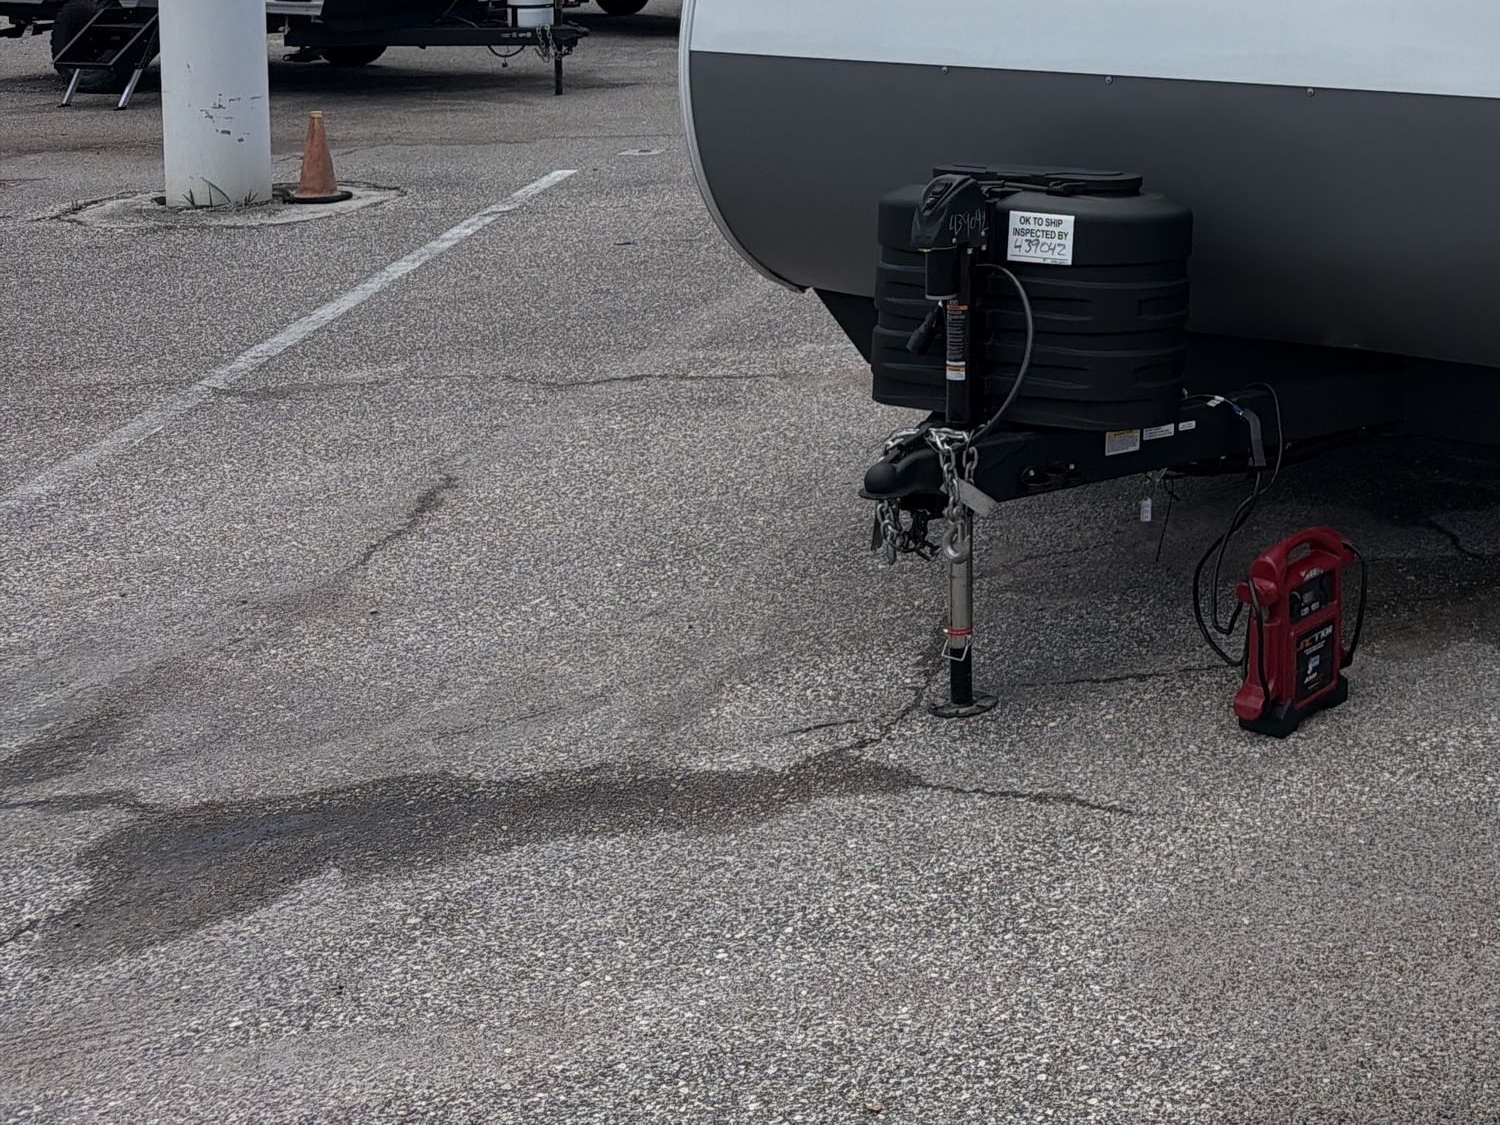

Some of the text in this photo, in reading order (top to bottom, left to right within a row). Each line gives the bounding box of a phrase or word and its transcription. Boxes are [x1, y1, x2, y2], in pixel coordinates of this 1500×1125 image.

[1020, 216, 1063, 228] OK TO SHIP
[1013, 228, 1069, 241] INSPECTED BY
[1013, 239, 1066, 256] 439042
